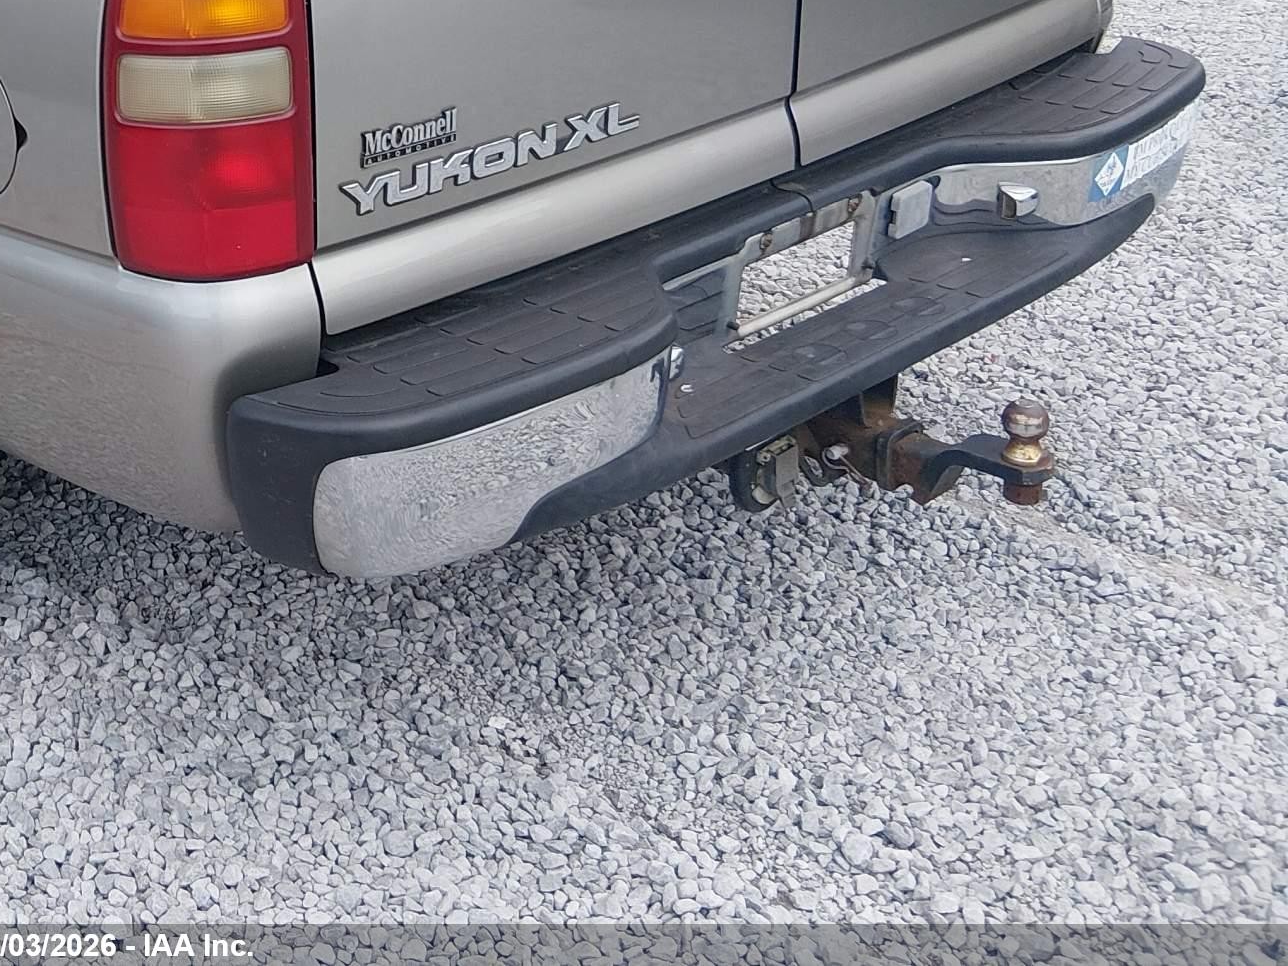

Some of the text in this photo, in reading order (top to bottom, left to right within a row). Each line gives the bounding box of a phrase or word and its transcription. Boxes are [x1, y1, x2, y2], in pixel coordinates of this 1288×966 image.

[340, 101, 640, 216] YUKON XL
[361, 106, 457, 156] McConnell
